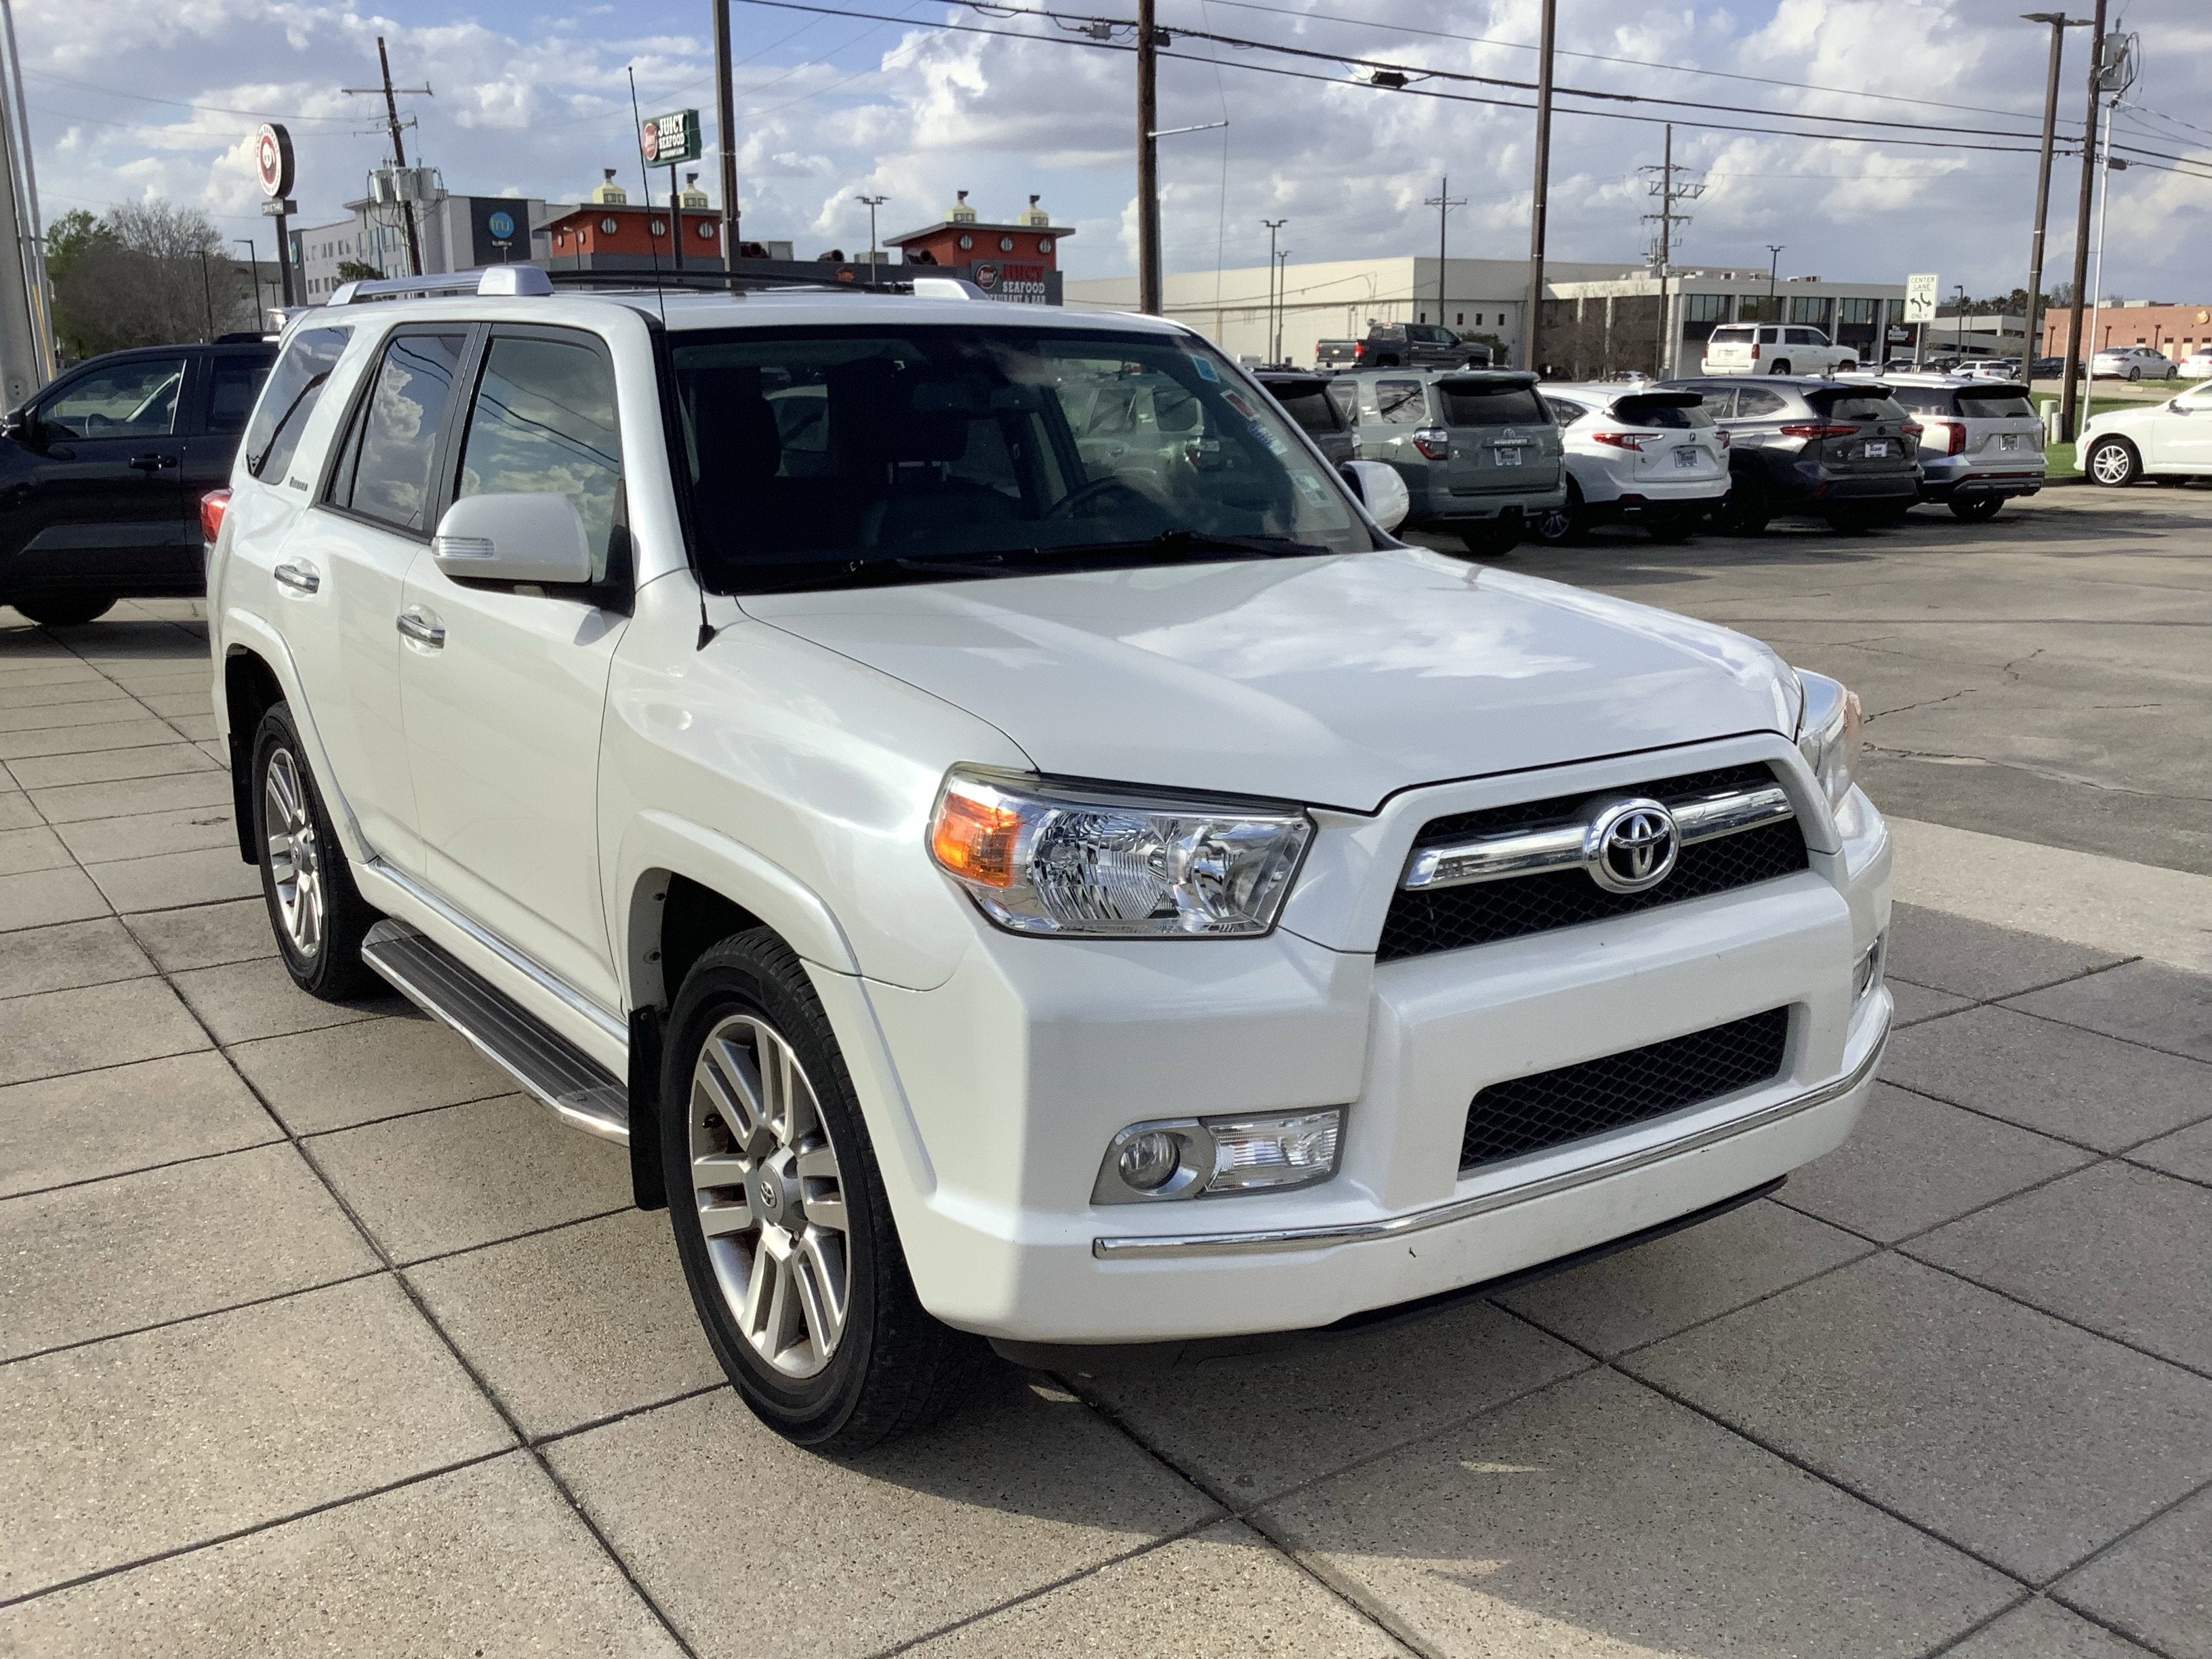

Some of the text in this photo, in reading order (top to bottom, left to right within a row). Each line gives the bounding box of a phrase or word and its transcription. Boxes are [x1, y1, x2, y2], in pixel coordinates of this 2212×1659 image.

[658, 114, 684, 136] JUICY
[659, 132, 685, 150] SEAFOOD
[1000, 264, 1042, 282] JUICY
[1002, 281, 1045, 293] SEAFOOD
